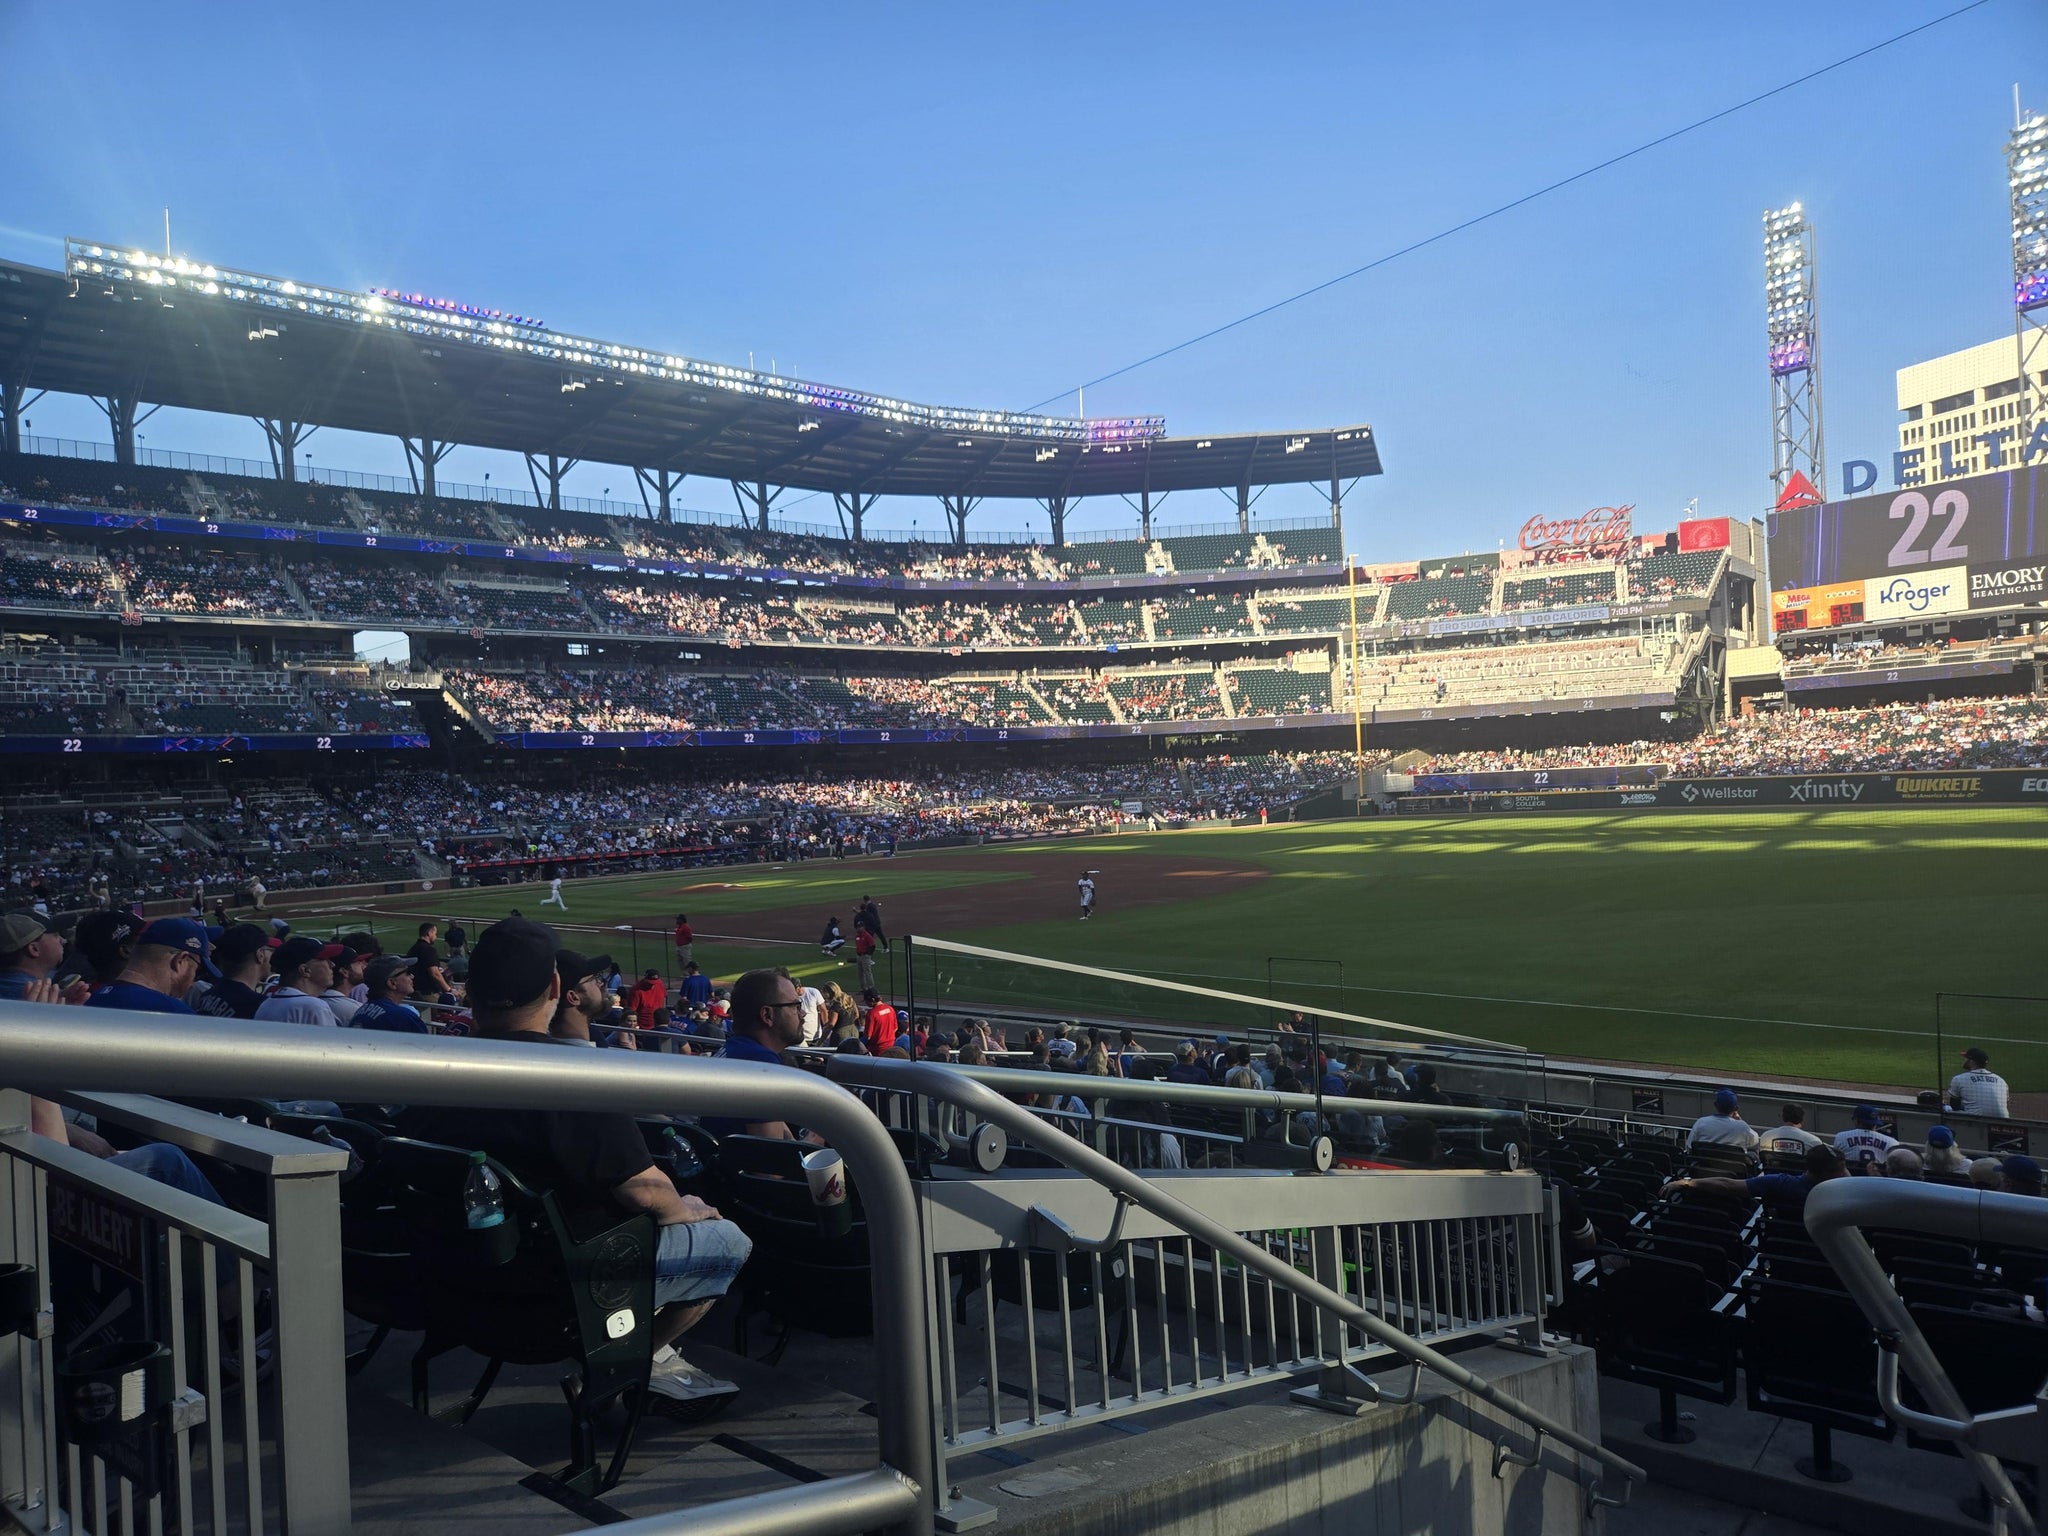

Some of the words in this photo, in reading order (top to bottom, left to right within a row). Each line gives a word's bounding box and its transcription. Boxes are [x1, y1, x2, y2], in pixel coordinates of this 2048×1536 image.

[1842, 421, 2048, 494] DELTA
[25, 509, 37, 519] 22
[207, 524, 218, 533] 22
[1518, 504, 1636, 550] Coca-Cola
[1888, 489, 1969, 567] 22
[366, 537, 377, 546] 22
[505, 549, 514, 557] 22
[627, 559, 636, 567] 22
[735, 567, 742, 575] 22
[831, 575, 838, 583] 22
[1971, 566, 2047, 590] EMORY
[1880, 578, 1950, 611] Kroger
[1973, 583, 2044, 598] HEALTHCARE
[1787, 594, 1811, 603] MEGA
[1531, 614, 1550, 623] 100
[1552, 608, 1606, 621] CALORIES
[1611, 607, 1628, 616] 7:09
[1630, 605, 1643, 614] PM
[121, 612, 142, 626] 35
[1432, 621, 1459, 632] ZERO
[1462, 619, 1495, 630] SUGAR
[470, 626, 484, 639] 41
[1887, 672, 1898, 681] 22
[401, 682, 441, 690] LEXUS
[1583, 700, 1593, 709] 22
[1422, 710, 1432, 719] 22
[1275, 718, 1285, 727] 22
[999, 730, 1008, 739] 22
[1132, 725, 1142, 734] 22
[582, 735, 594, 746] 22
[744, 733, 754, 743] 22
[881, 732, 890, 741] 22
[64, 739, 82, 752] 22
[317, 736, 331, 749] 22
[1534, 772, 1549, 784] 22
[1789, 779, 1865, 801] xfinity
[1895, 777, 1982, 793] QUIKRETE
[1701, 787, 1758, 799] Wellstar
[1970, 1075, 1984, 1083] BAT
[1986, 1075, 1999, 1084] BOY
[1847, 1135, 1888, 1151] DAWSON
[55, 1186, 77, 1232] BE
[81, 1198, 133, 1262] ALERT
[617, 1316, 625, 1332] 3
